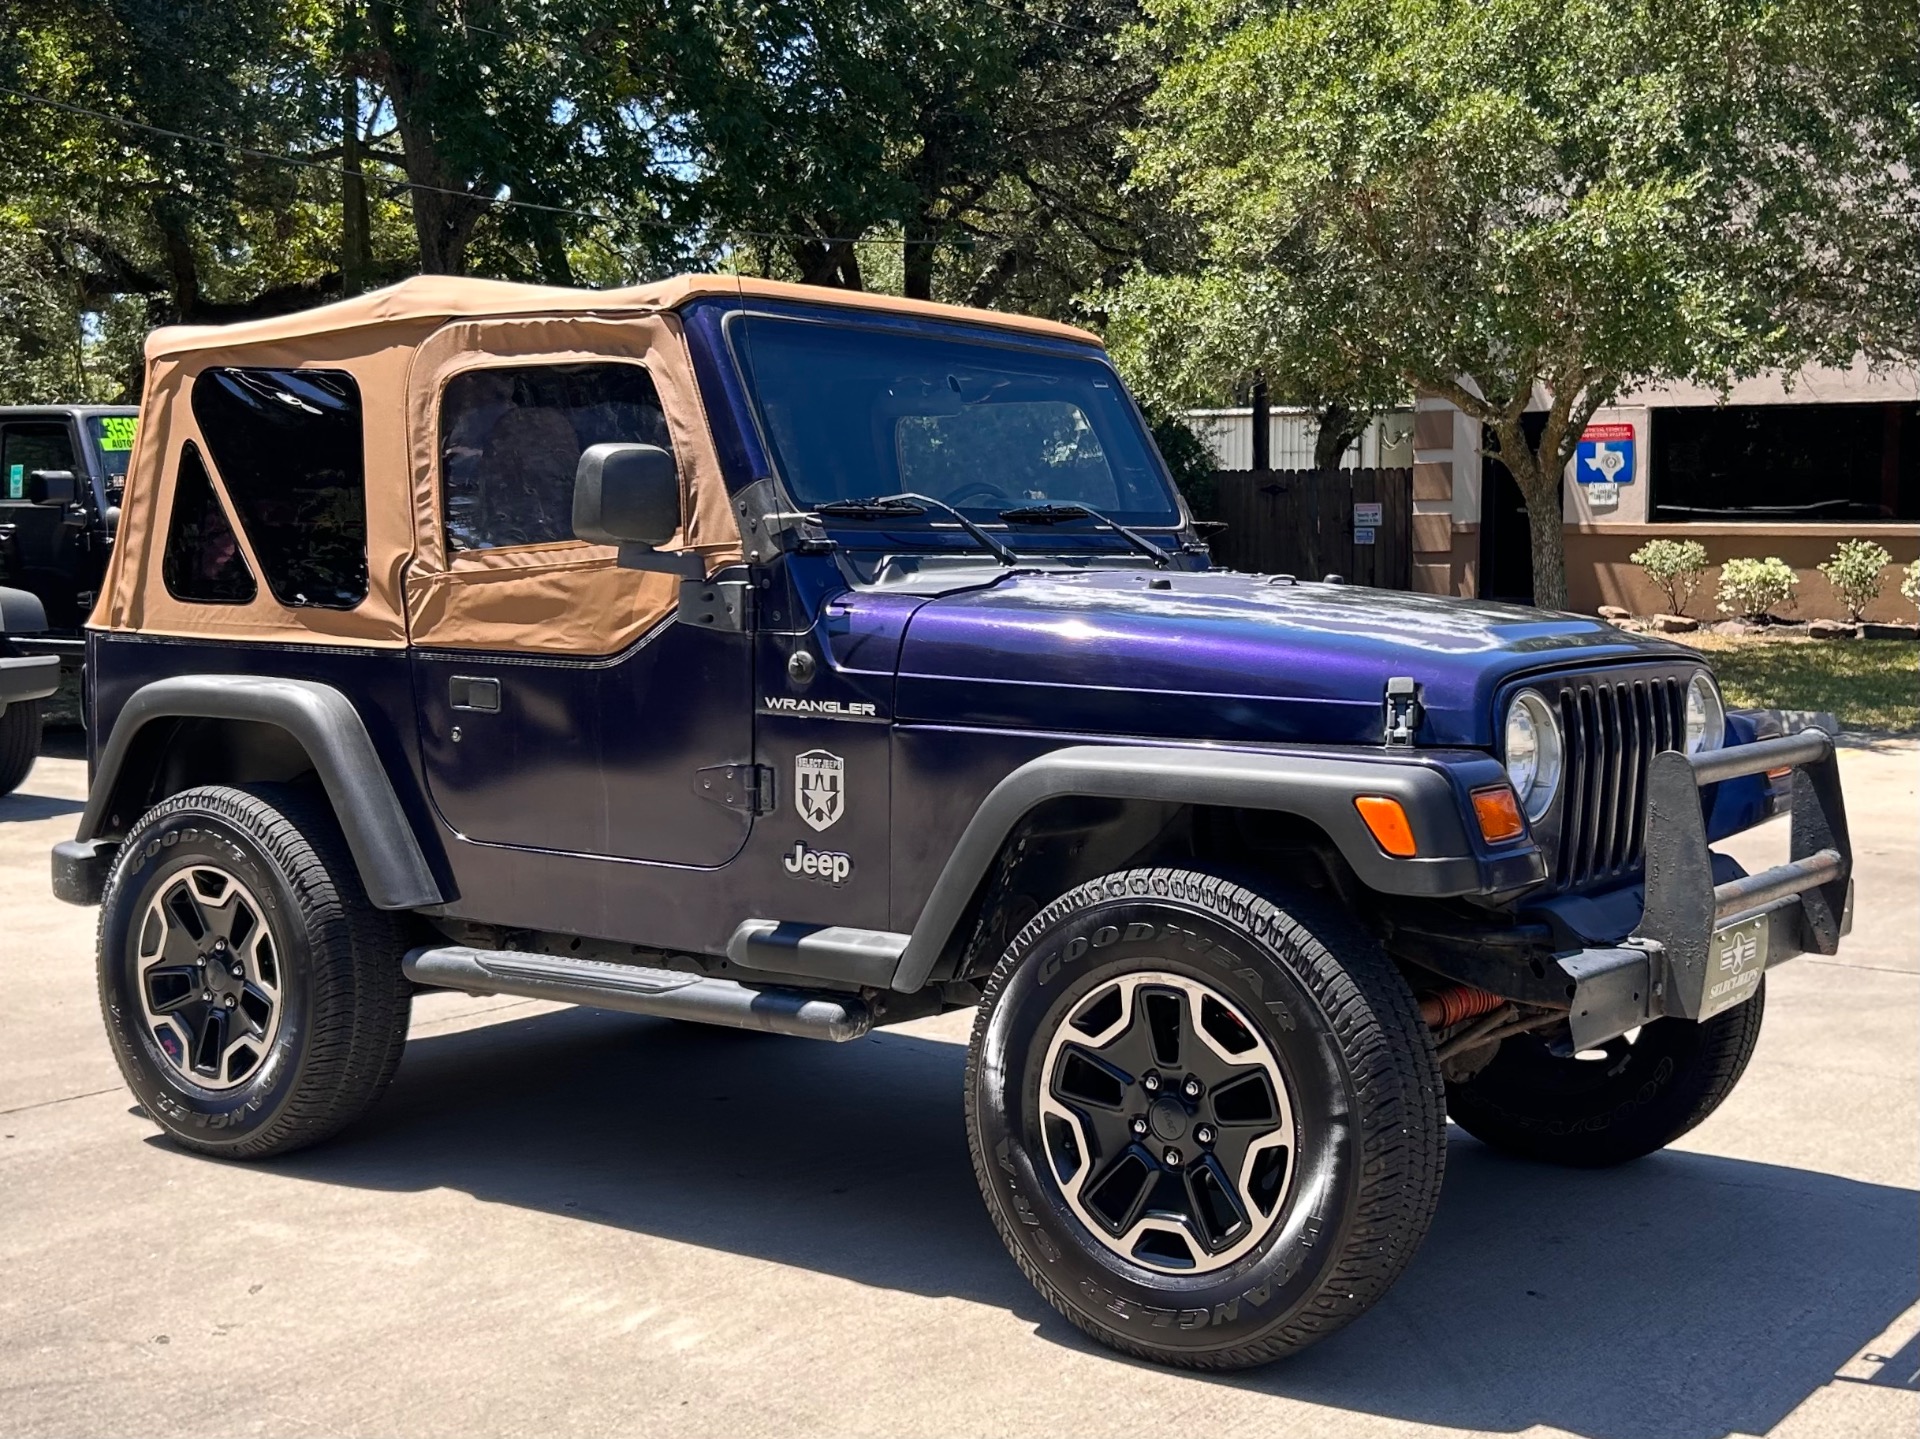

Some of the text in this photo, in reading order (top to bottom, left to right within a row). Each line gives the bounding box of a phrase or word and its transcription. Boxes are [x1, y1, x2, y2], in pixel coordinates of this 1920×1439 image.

[112, 439, 135, 448] AUTO
[764, 697, 876, 716] WRANGLER
[798, 757, 842, 770] SELECT JEEPS
[784, 844, 850, 882] Jeep
[1038, 922, 1297, 1032] GOODYEAR
[1080, 1215, 1323, 1331] WRANGLER
